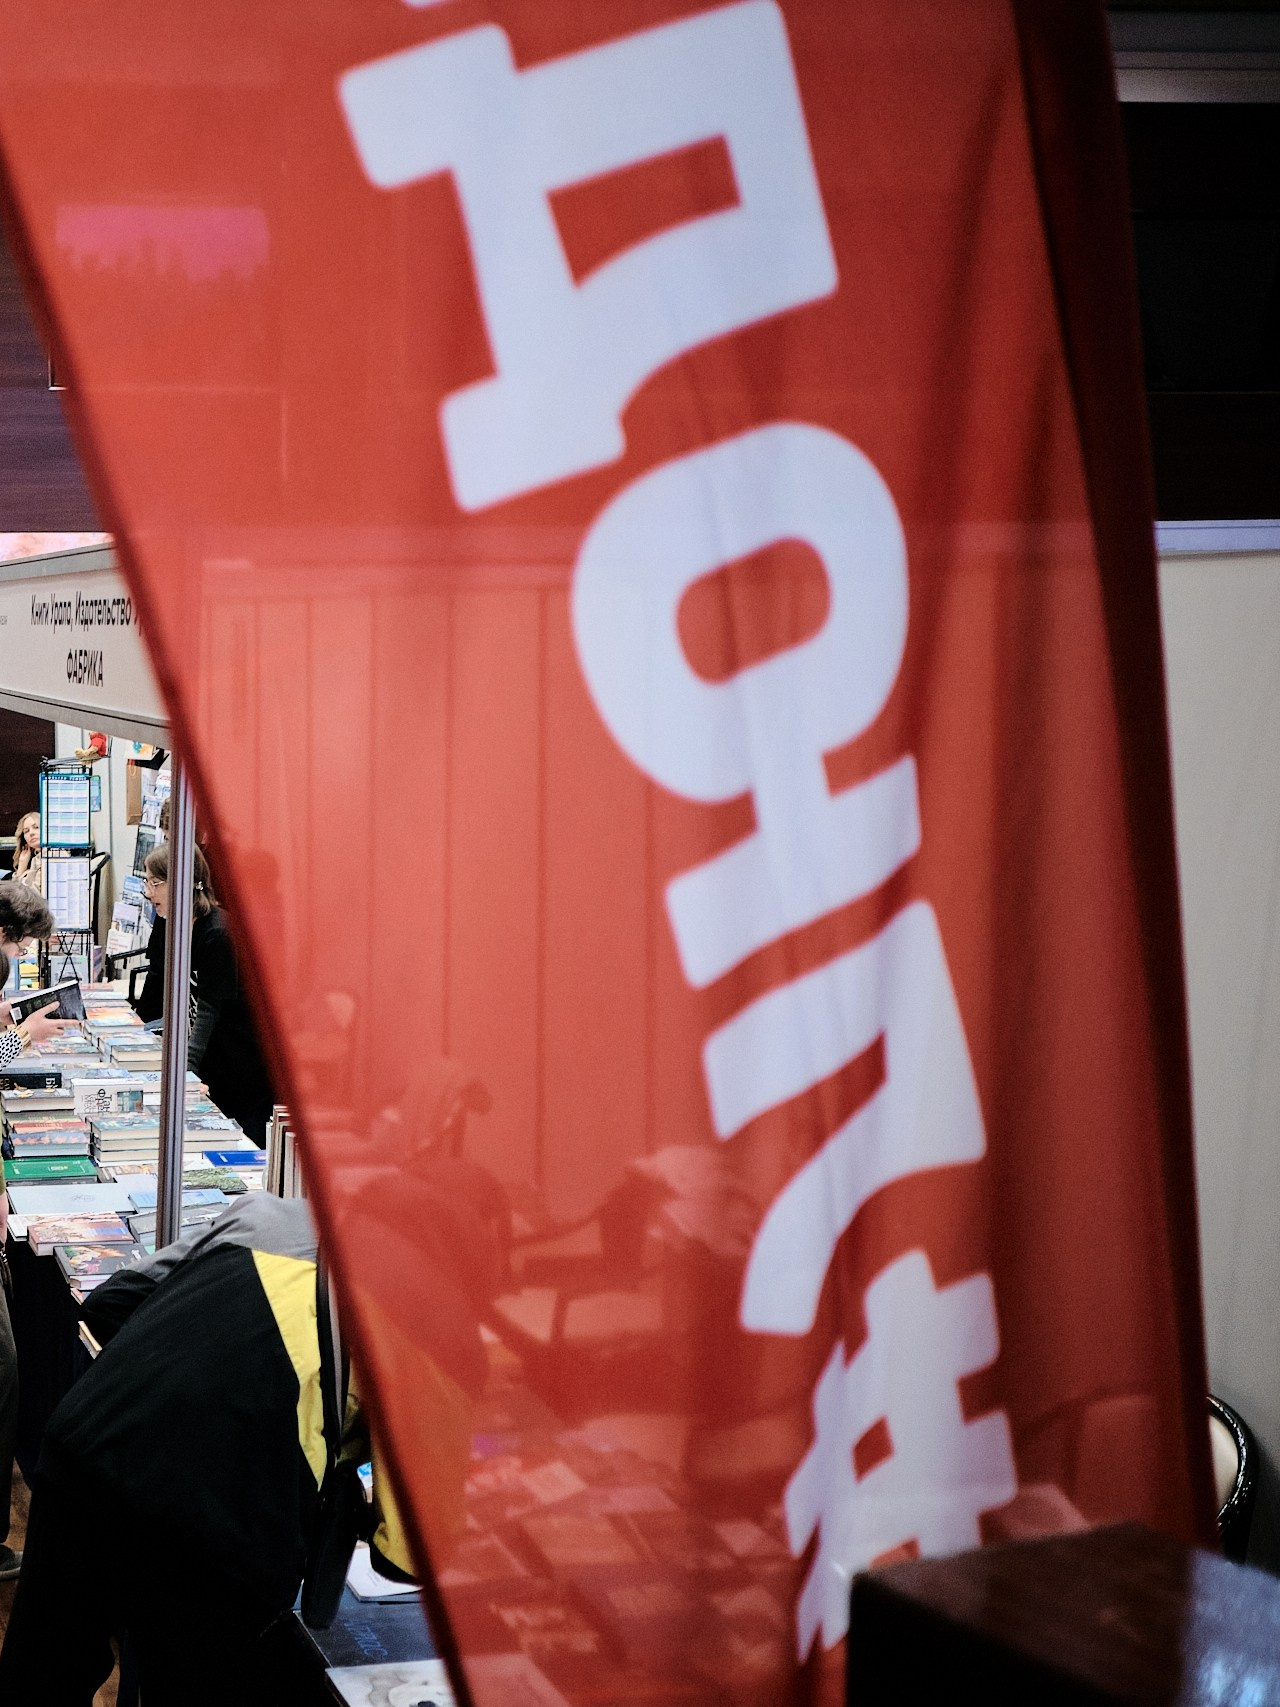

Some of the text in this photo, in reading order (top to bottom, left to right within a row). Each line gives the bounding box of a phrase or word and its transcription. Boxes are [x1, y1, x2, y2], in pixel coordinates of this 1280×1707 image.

[31, 594, 49, 625] Книги
[50, 593, 73, 634] Урала,
[75, 591, 132, 632] Издательство
[66, 649, 104, 688] ФАБРИКА
